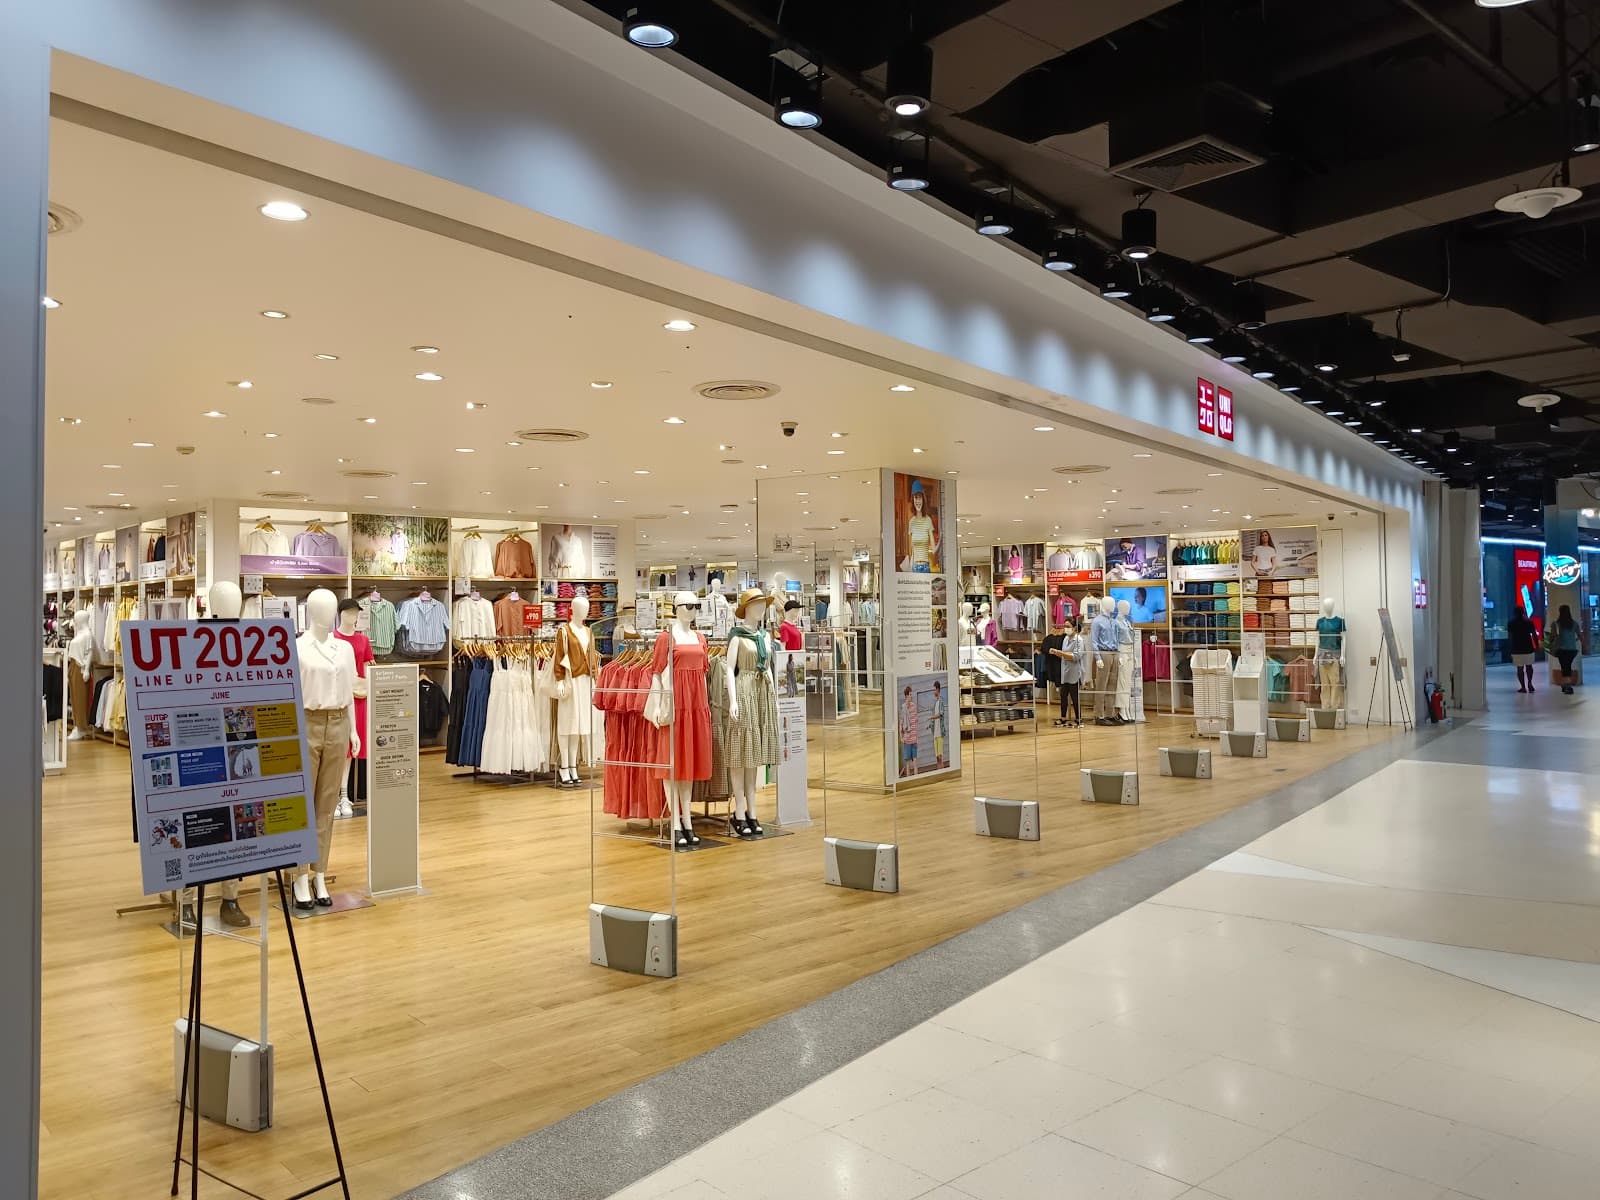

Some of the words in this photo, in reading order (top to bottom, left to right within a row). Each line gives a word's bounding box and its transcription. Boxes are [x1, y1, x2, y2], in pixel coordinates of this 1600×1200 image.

[1219, 394, 1231, 414] UNI
[1219, 414, 1232, 434] QLO
[130, 627, 188, 672] UT
[193, 625, 291, 669] 2023
[134, 674, 173, 687] LINE
[185, 673, 204, 684] UP
[215, 668, 294, 683] CALENDAR
[210, 691, 230, 699] JUNE
[221, 788, 239, 798] JULY
